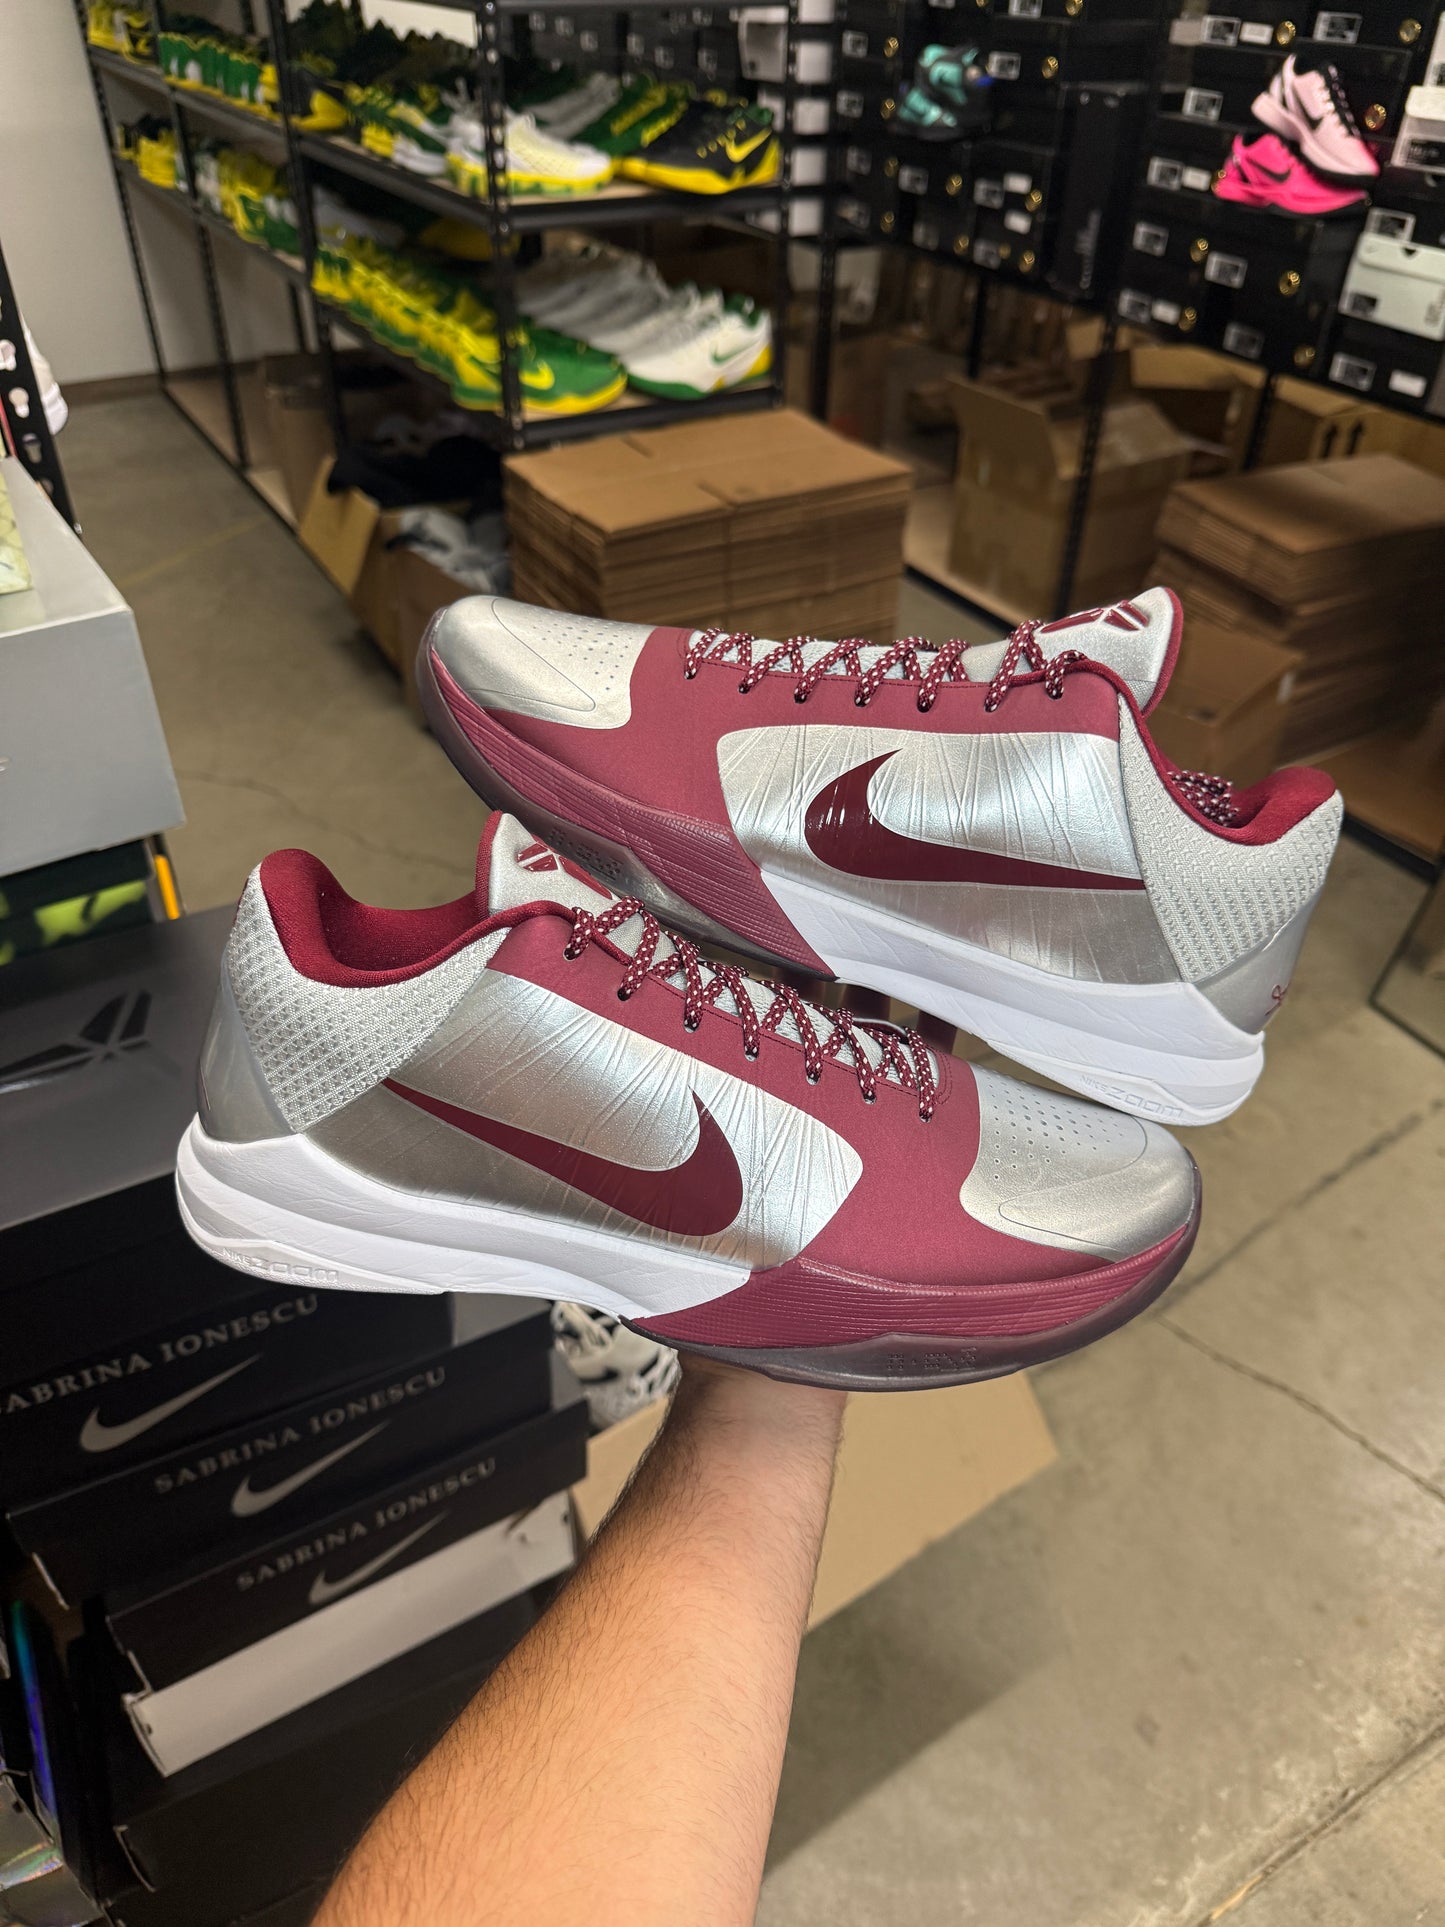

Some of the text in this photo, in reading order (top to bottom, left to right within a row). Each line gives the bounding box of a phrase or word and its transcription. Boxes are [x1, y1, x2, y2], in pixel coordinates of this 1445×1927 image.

[223, 1248, 250, 1265] NIKE
[0, 1293, 320, 1413] ABRINA IONESCU
[153, 1366, 446, 1494] SABRINA IONESCU
[236, 1457, 497, 1591] SABRINA IONESCU
